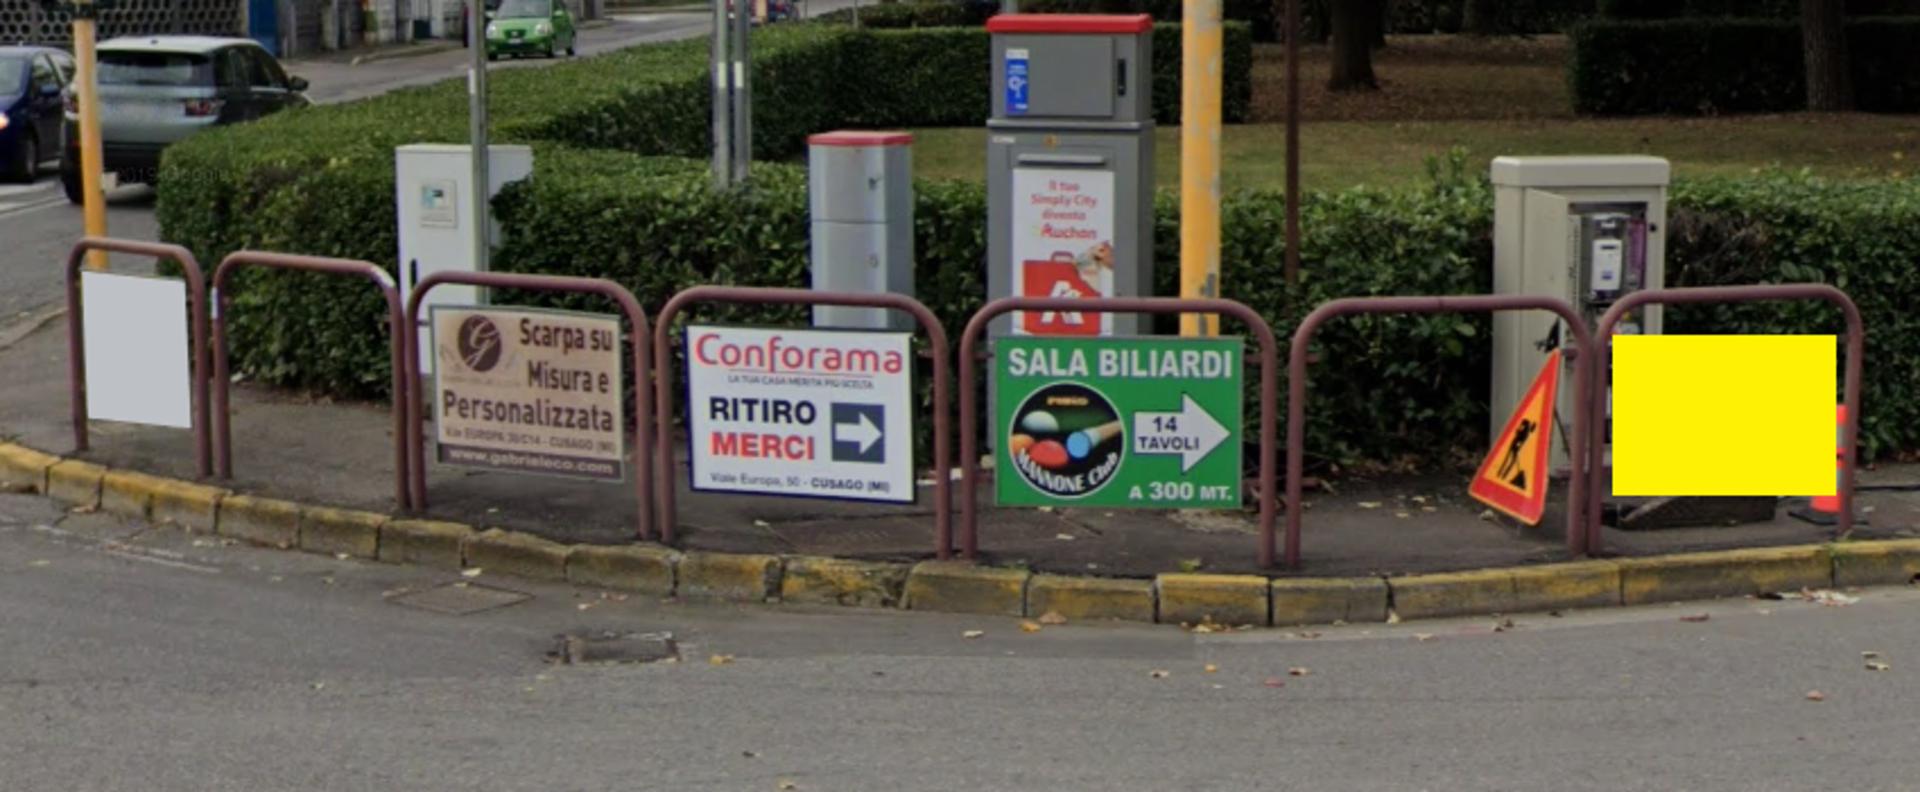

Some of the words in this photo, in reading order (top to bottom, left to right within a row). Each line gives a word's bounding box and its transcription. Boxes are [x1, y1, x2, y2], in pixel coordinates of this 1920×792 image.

[1041, 223, 1097, 239] Auchan
[519, 317, 585, 354] Scarpa
[590, 328, 613, 351] su
[695, 333, 903, 374] Conforama
[1008, 347, 1089, 377] SALA
[1100, 348, 1233, 378] BILIARDI
[527, 360, 592, 392] Misura
[598, 373, 610, 394] e
[443, 389, 614, 432] Personalizzata
[708, 396, 817, 425] RITIRO
[1153, 415, 1178, 432] 14
[710, 431, 815, 460] MERCI
[1138, 436, 1200, 451] TAVOLI
[709, 472, 736, 483] Viale
[810, 476, 863, 490] CUSAGO
[867, 480, 891, 493] (MI)
[1128, 485, 1143, 499] A
[1148, 480, 1195, 500] 300
[1199, 485, 1234, 501] MT.
